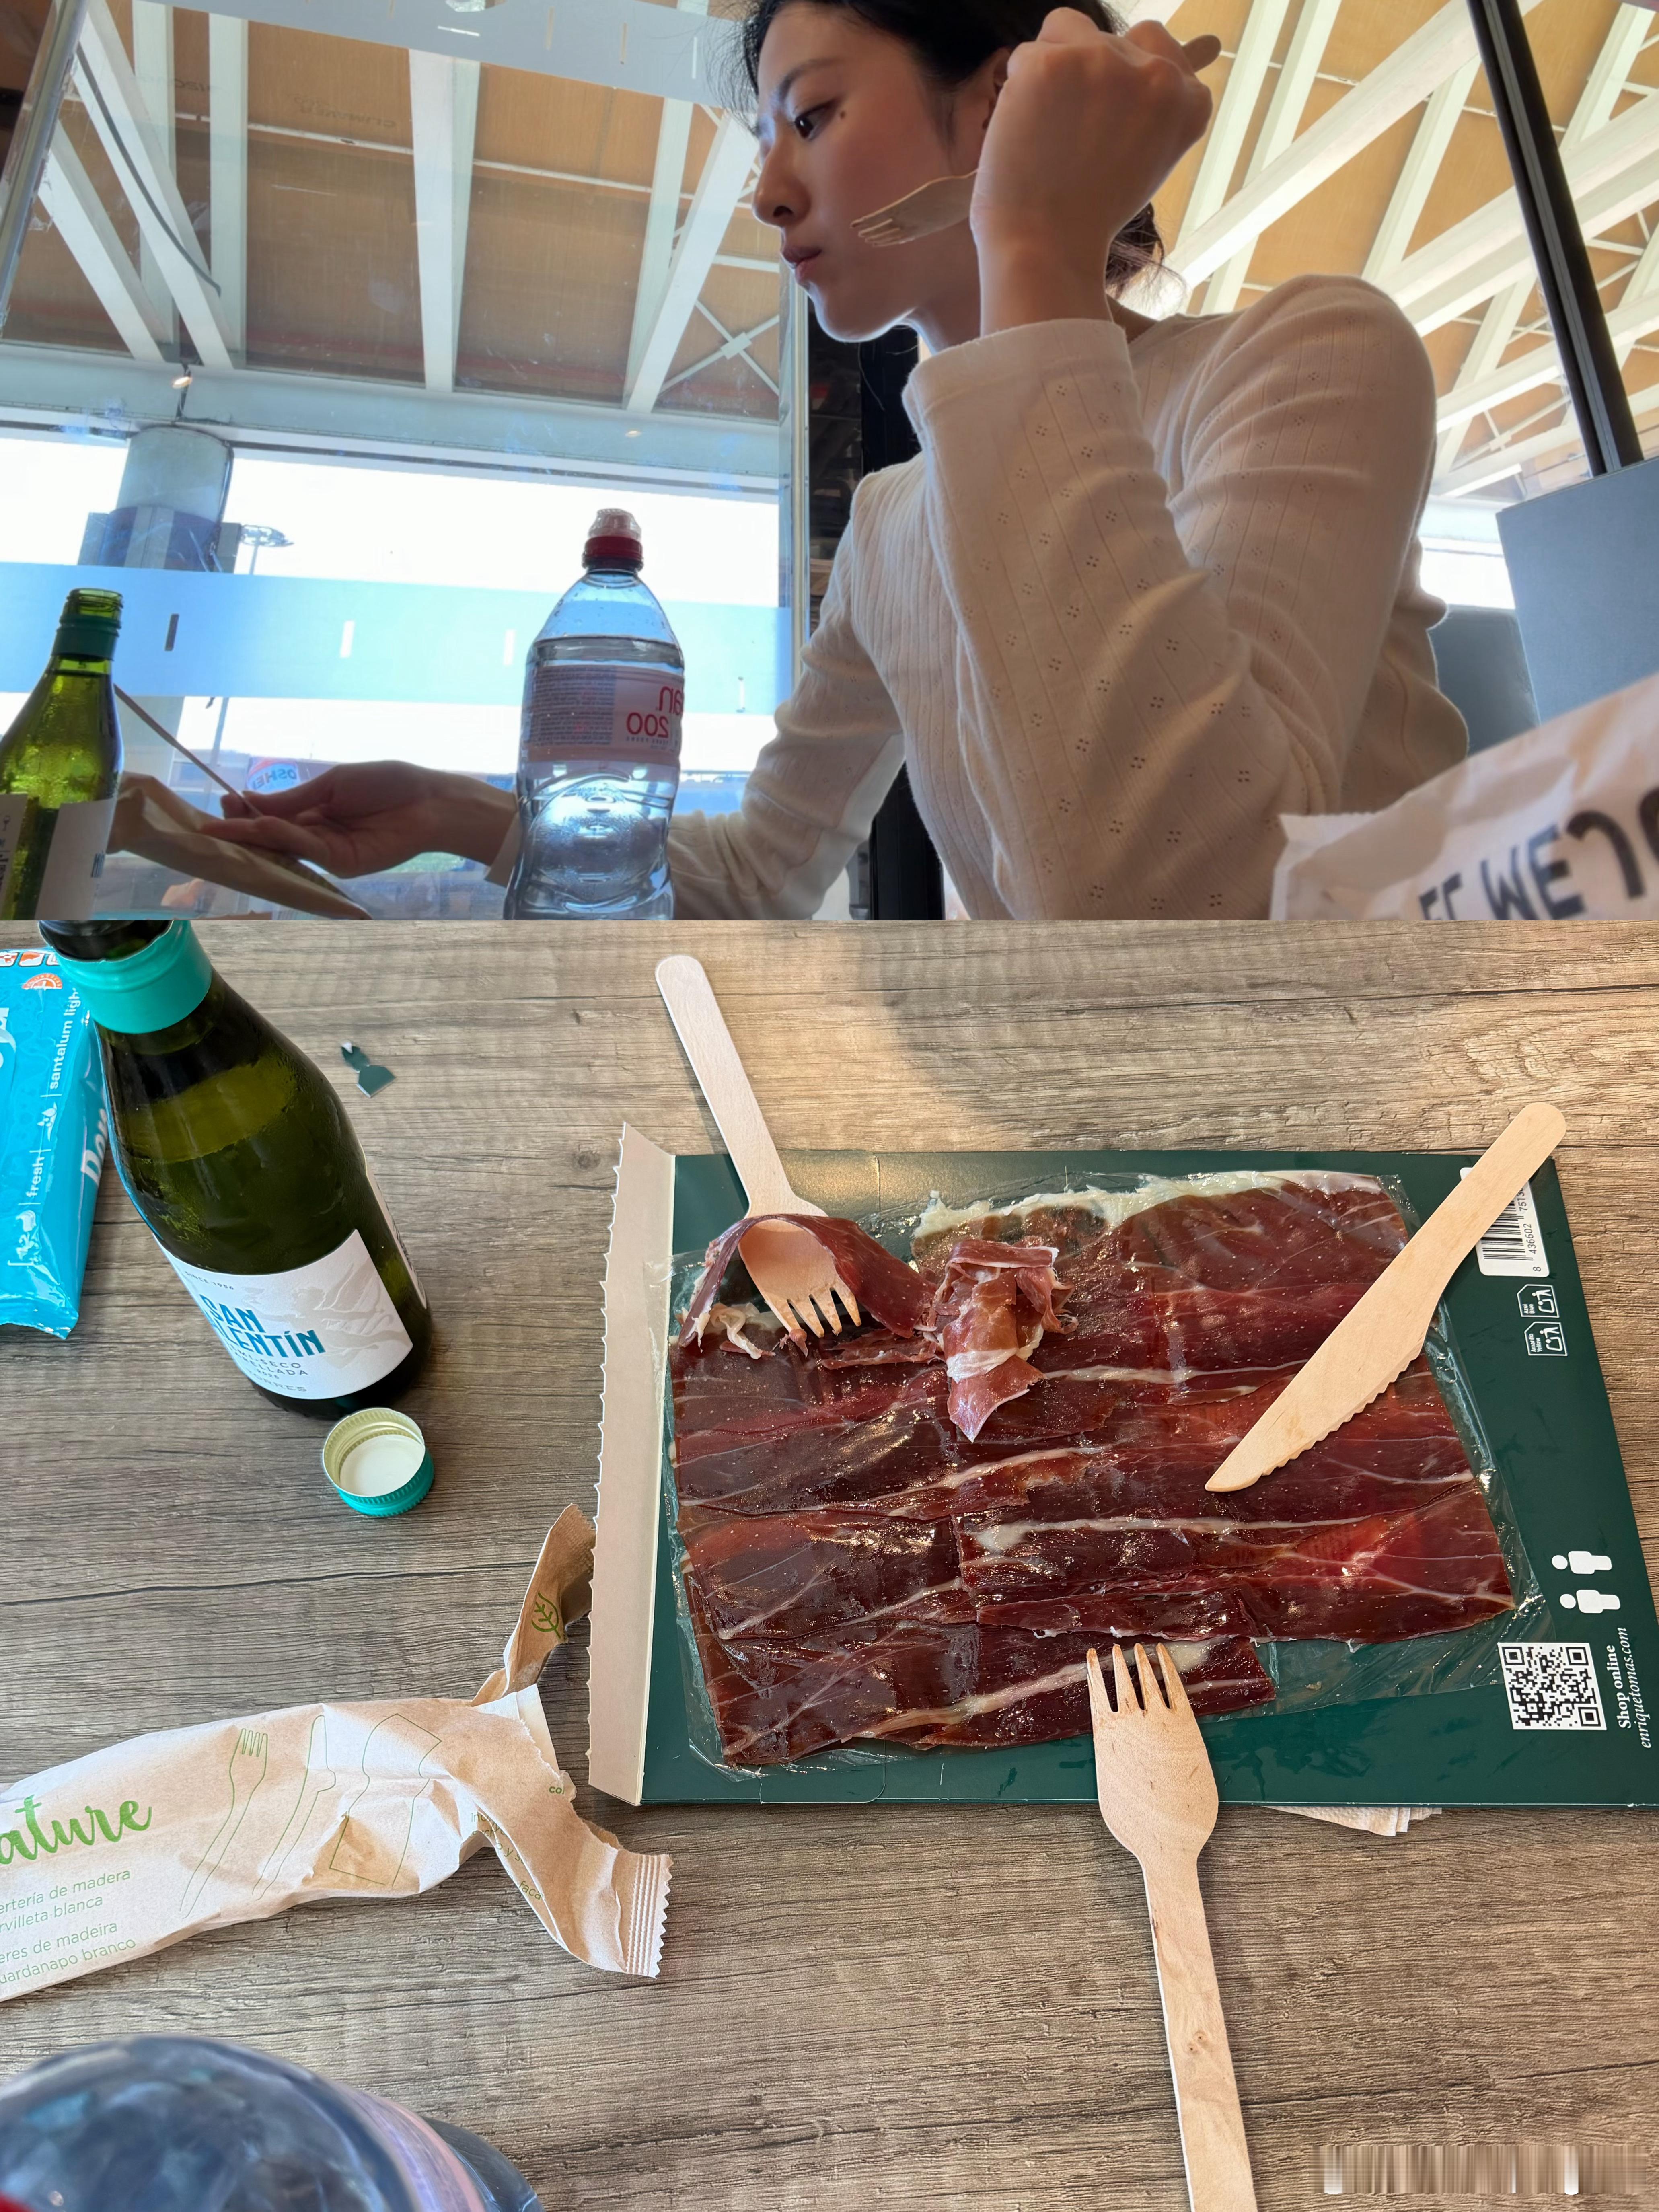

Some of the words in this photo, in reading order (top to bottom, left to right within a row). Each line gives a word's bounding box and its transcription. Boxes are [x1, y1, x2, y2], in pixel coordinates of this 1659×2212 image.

[50, 1020, 73, 1089] santalum
[26, 1156, 45, 1197] fresh
[1523, 1223, 1537, 1254] 436602
[199, 1294, 266, 1333] SAN
[1528, 1333, 1537, 1352] Amarillo
[1606, 1645, 1623, 1689] online
[1617, 1628, 1652, 1749] enriquetomas.com
[1616, 1692, 1632, 1729] Shop
[49, 1885, 68, 1900] de
[73, 1870, 130, 1893] madera
[53, 1896, 103, 1918] blanca
[33, 1939, 51, 1954] de
[57, 1922, 117, 1947] madeira
[82, 1939, 136, 1961] branco
